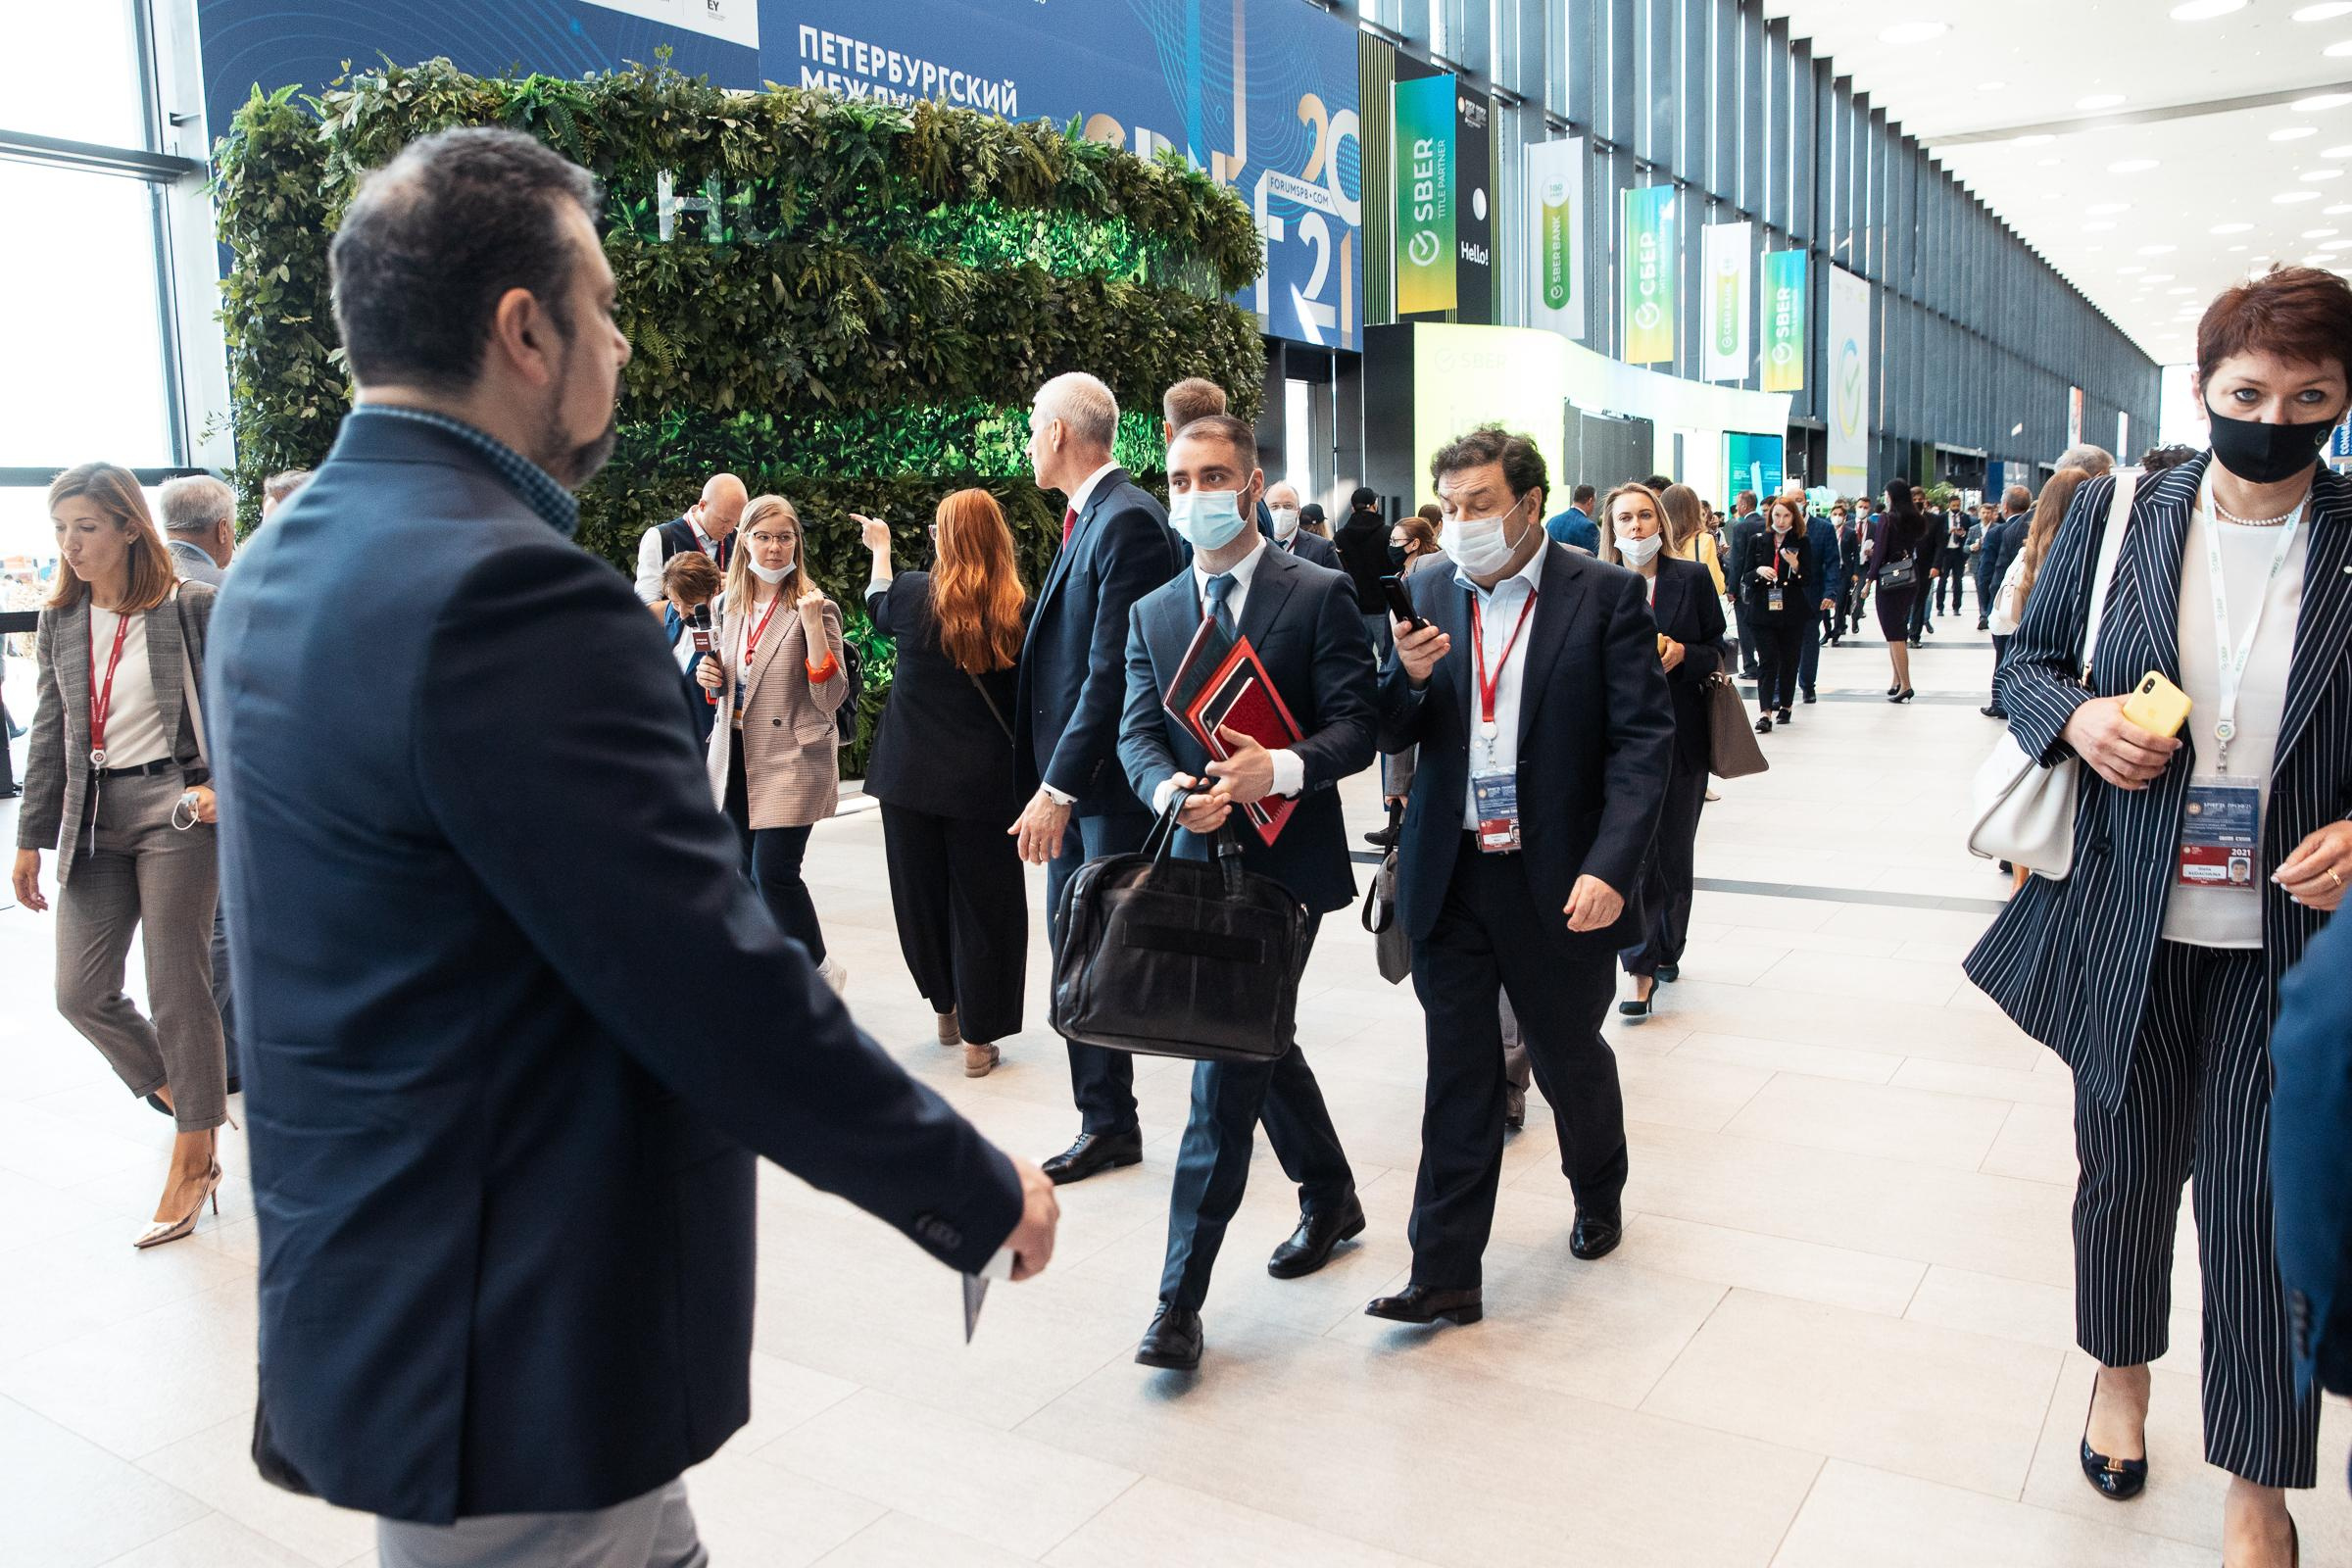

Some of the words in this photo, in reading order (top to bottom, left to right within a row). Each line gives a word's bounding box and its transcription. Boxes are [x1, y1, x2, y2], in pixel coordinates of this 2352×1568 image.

[799, 24, 1017, 118] ПЕТЕРБУРГСКИЙ
[1413, 137, 1434, 222] SBER
[1460, 241, 1489, 267] Hello!
[1640, 231, 1656, 296] СБЕР
[1775, 287, 1791, 338] SBER
[1459, 352, 1508, 369] SBER
[2231, 848, 2251, 857] 2021
